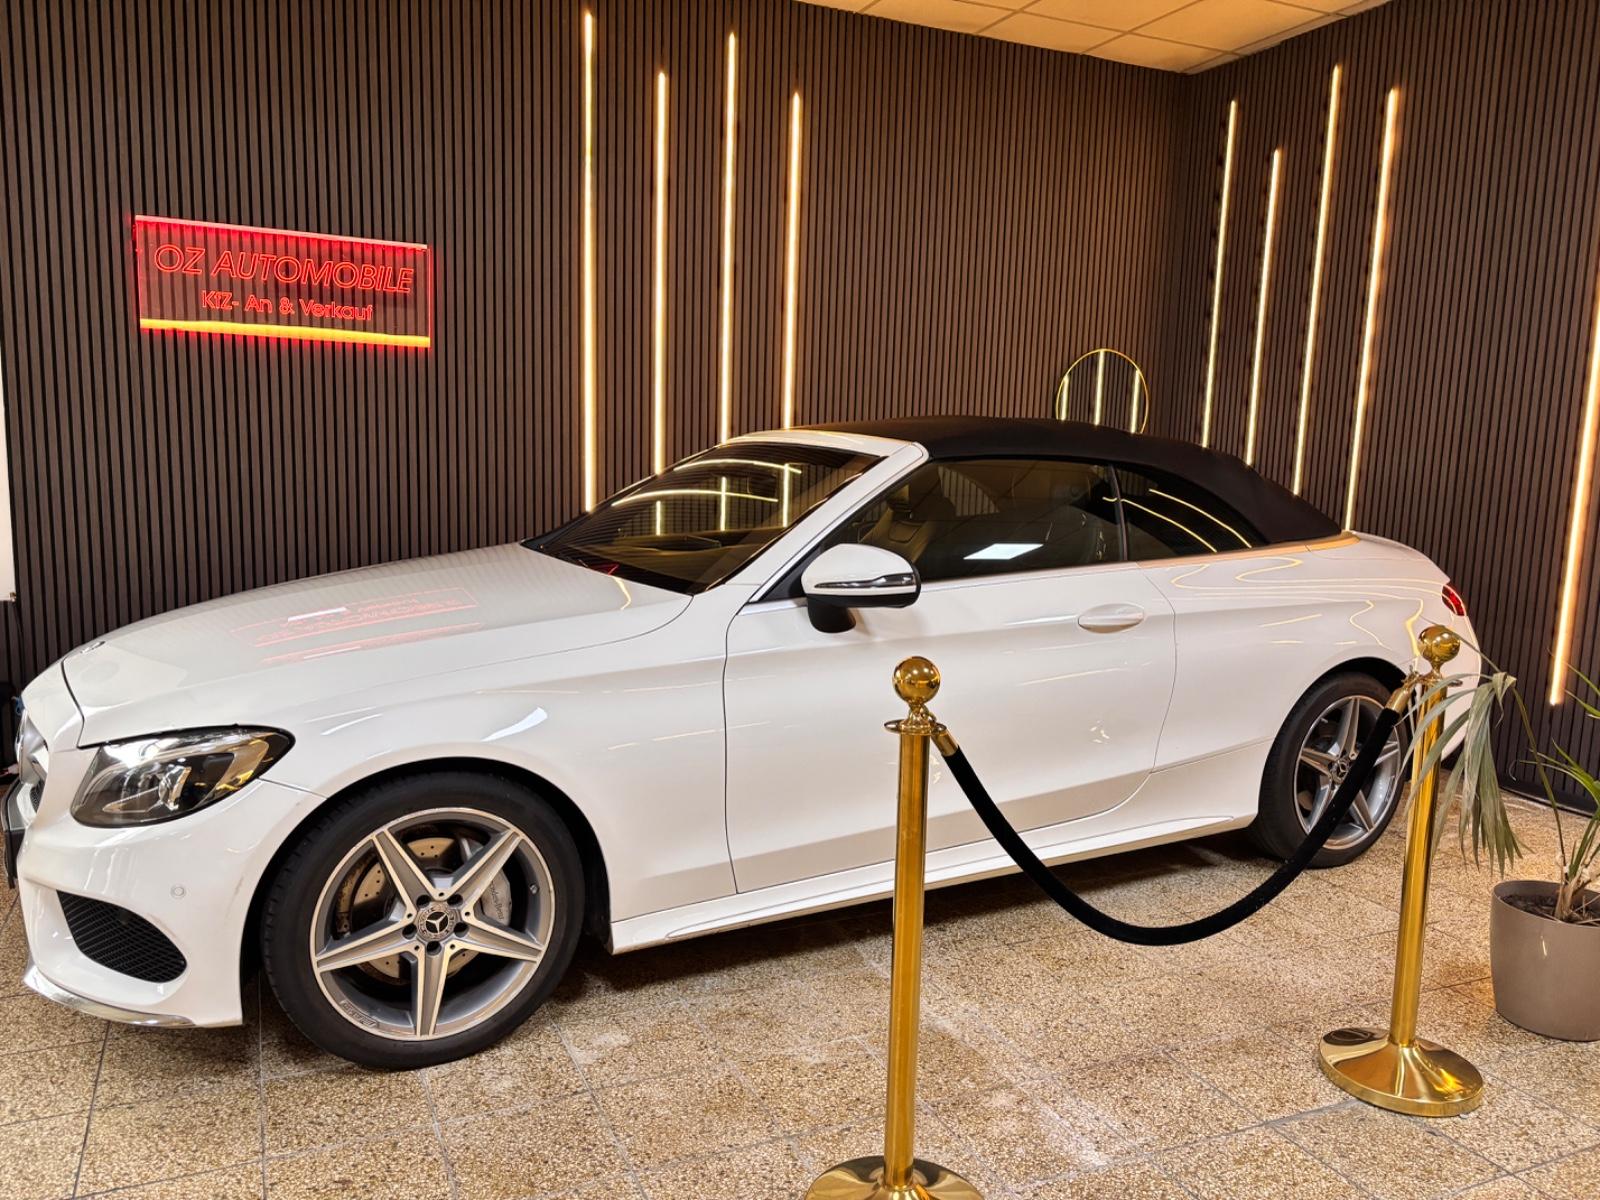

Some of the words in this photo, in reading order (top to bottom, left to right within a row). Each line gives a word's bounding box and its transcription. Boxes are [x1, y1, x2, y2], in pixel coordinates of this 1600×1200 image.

[154, 244, 206, 275] OZ
[211, 250, 414, 293] AUTOMOBILE
[244, 294, 273, 314] An
[279, 296, 296, 316] &
[299, 298, 374, 321] Verkauf
